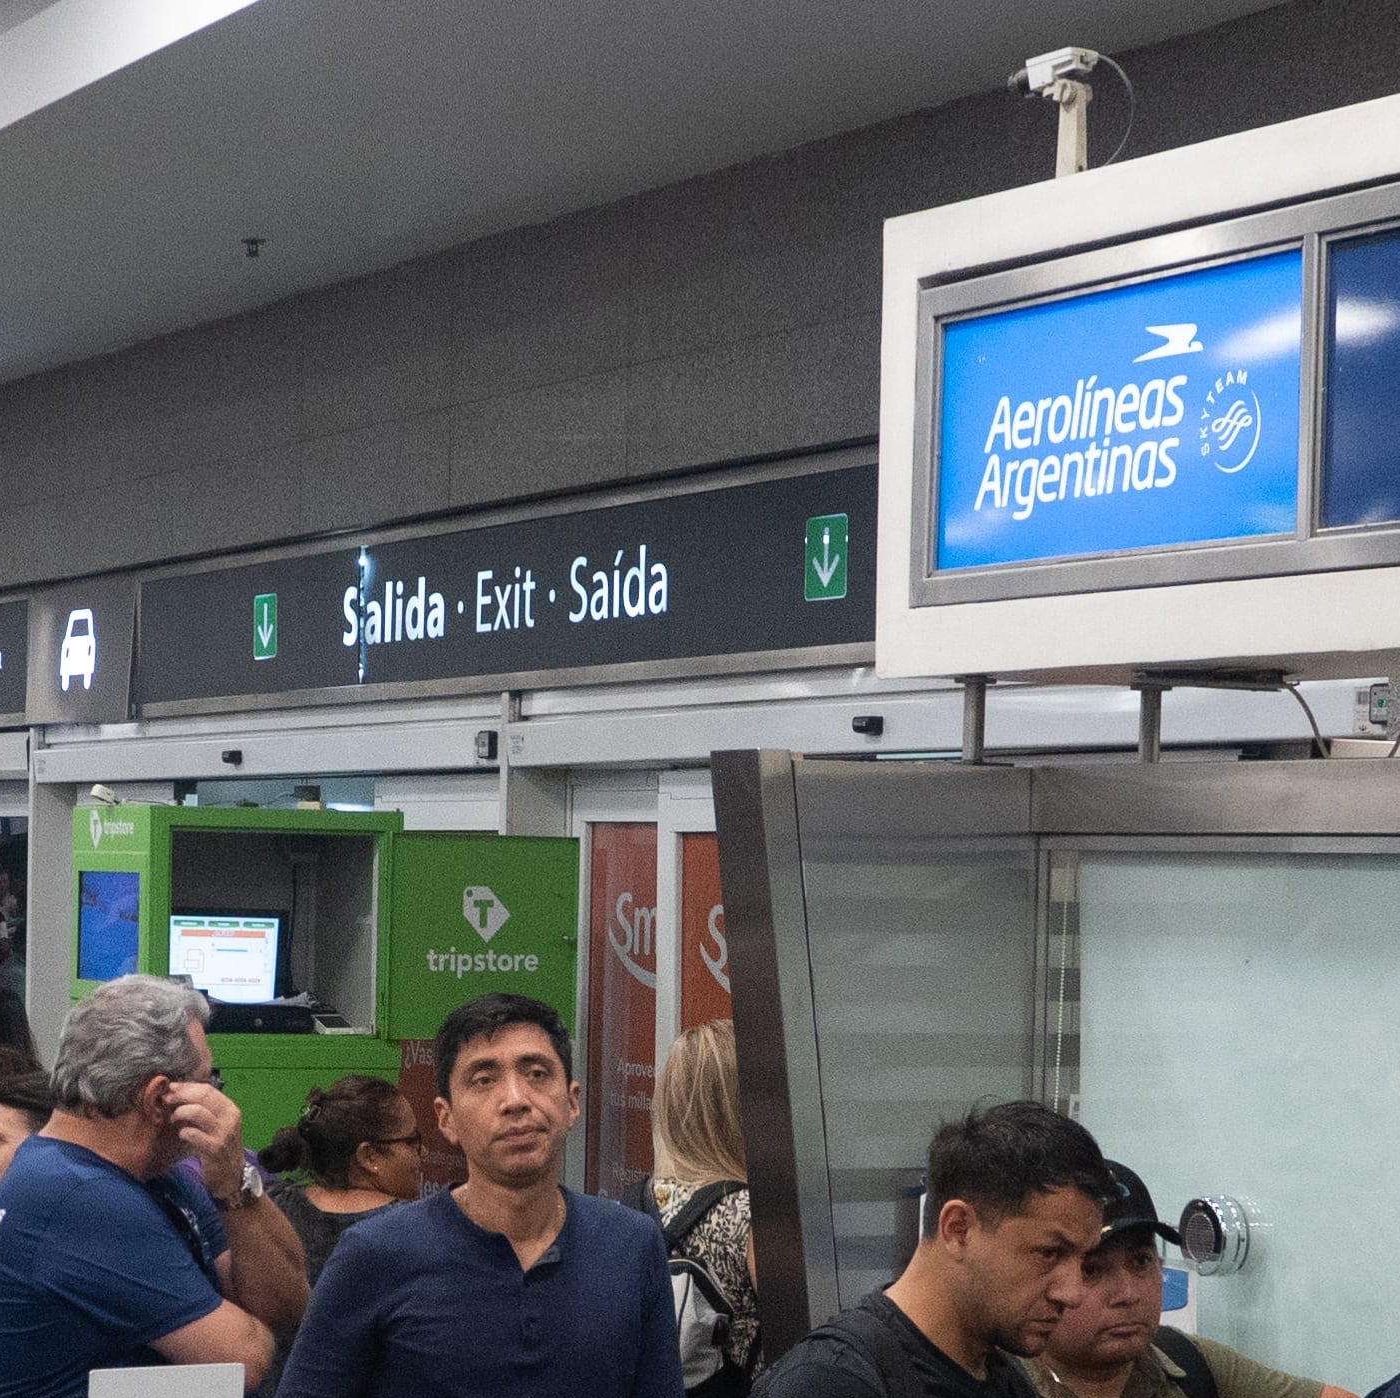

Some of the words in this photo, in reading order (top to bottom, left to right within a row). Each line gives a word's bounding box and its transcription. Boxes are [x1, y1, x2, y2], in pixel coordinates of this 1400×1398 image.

[984, 374, 1188, 454] Aerolíneas
[973, 437, 1180, 521] Argentinas
[342, 576, 446, 647] Salida
[476, 566, 536, 633] Exit
[569, 544, 669, 623] Saída
[103, 819, 135, 840] tripstore
[426, 946, 540, 978] tripstore
